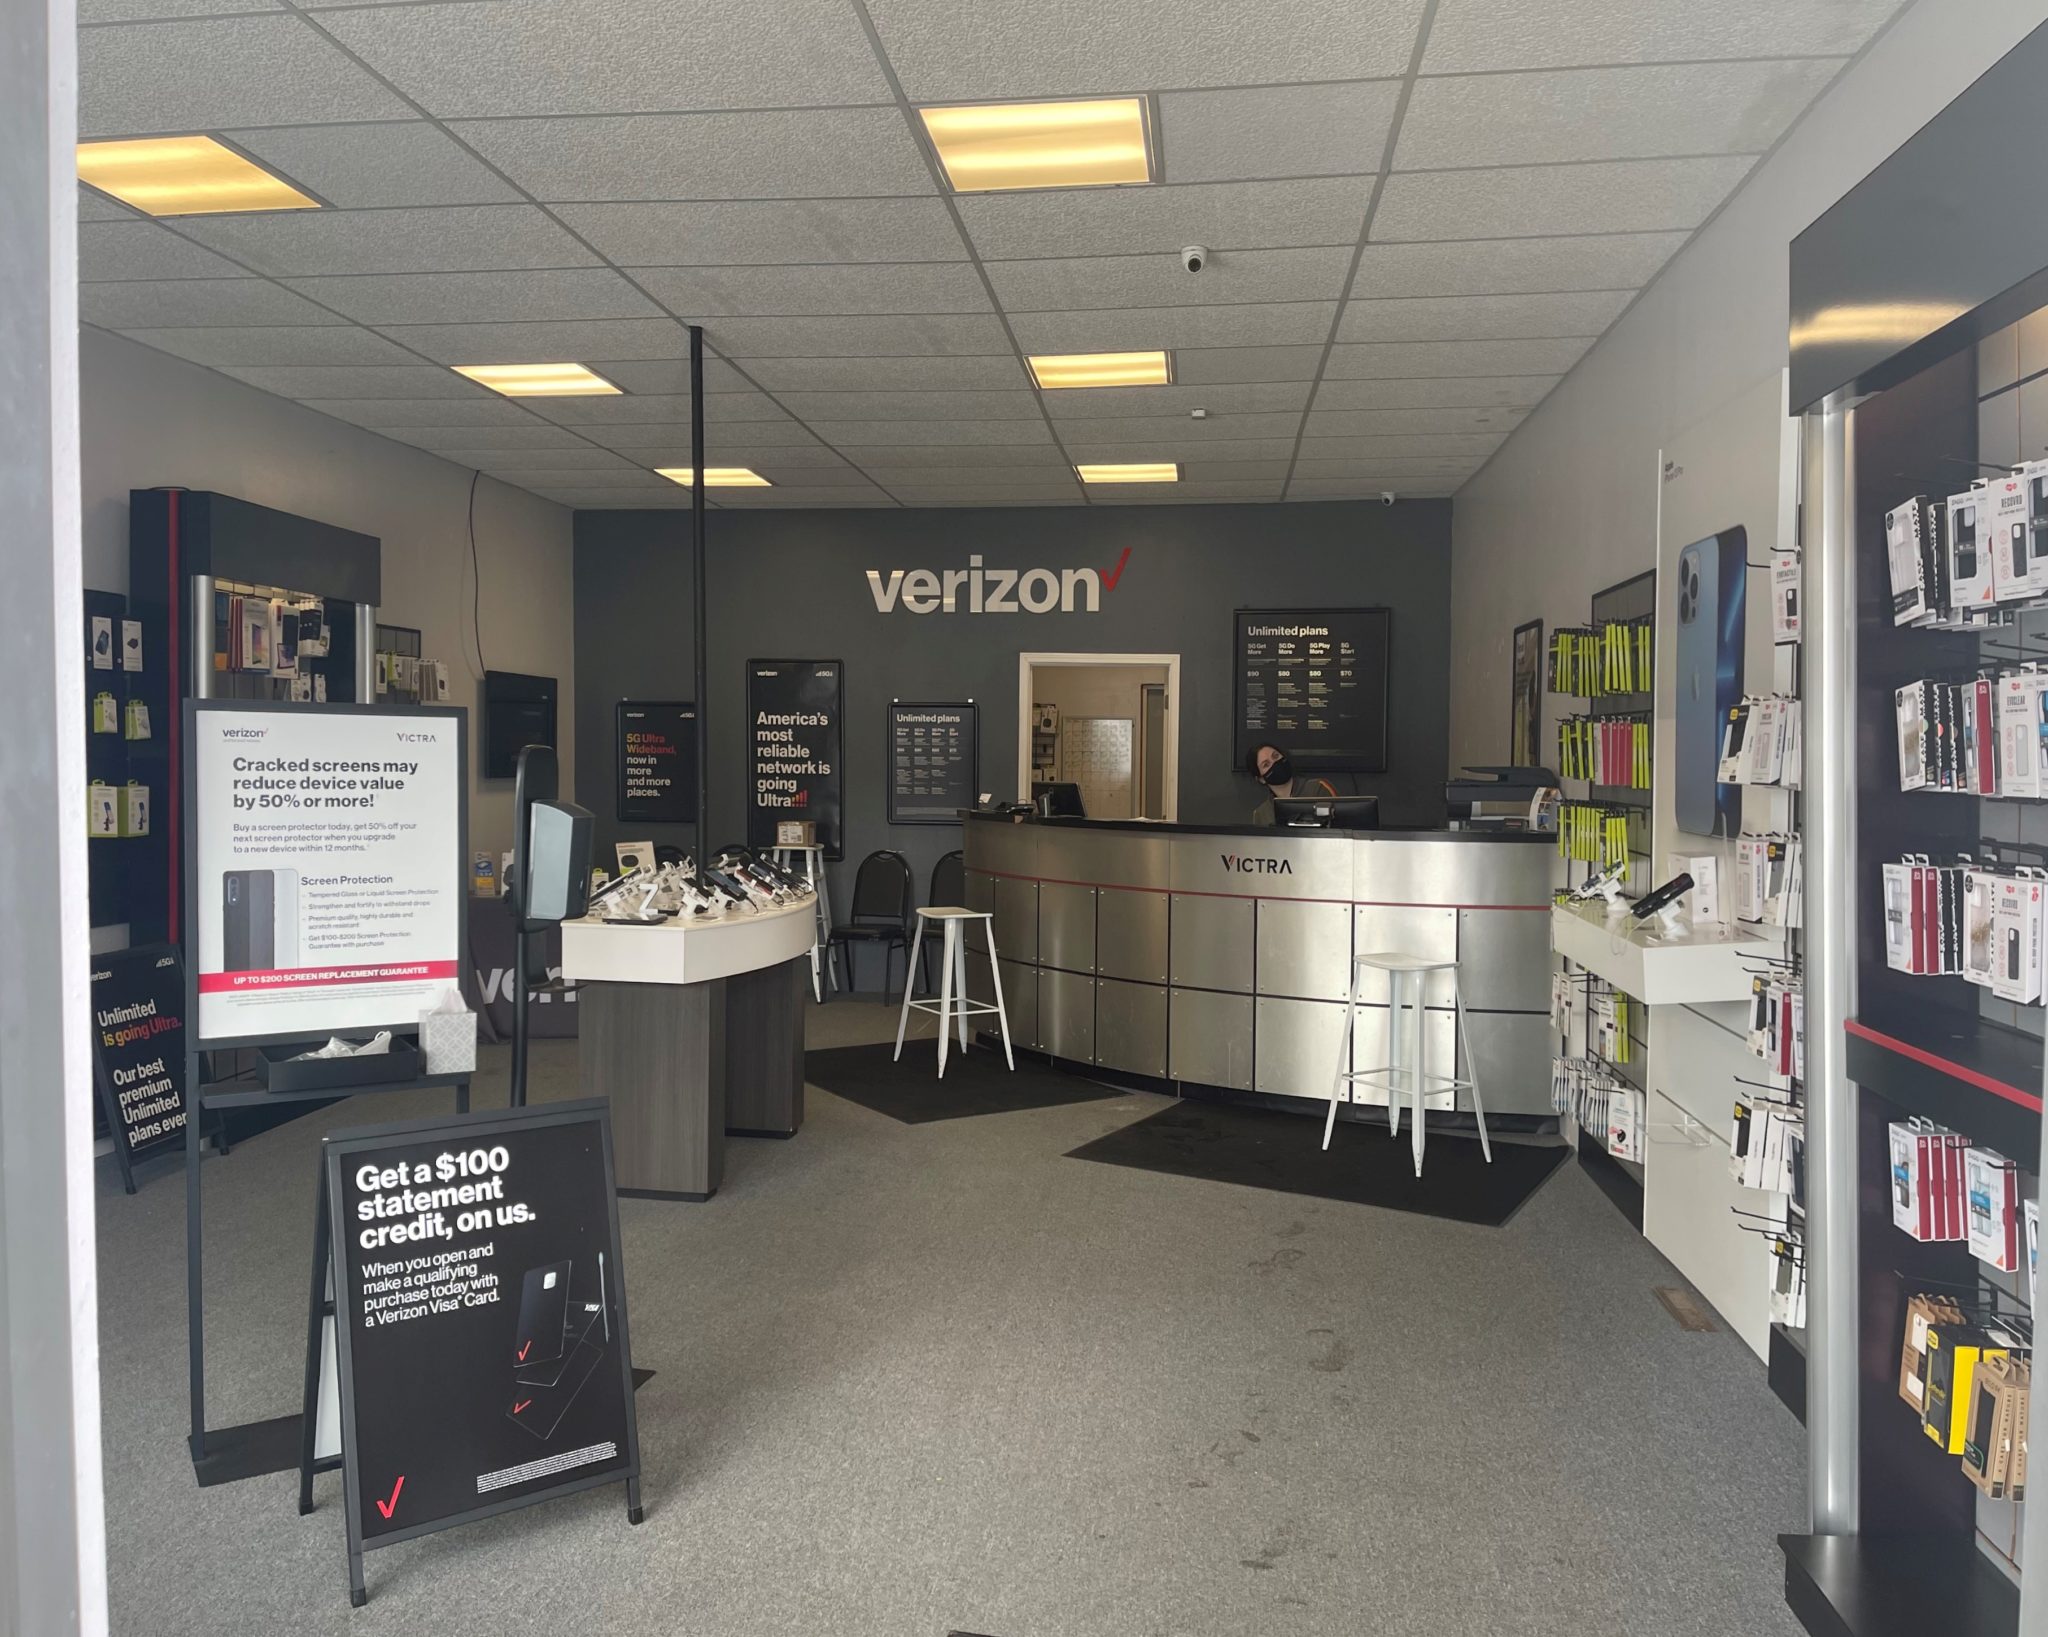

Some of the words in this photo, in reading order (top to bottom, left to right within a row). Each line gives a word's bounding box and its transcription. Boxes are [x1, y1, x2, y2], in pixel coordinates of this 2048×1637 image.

[866, 555, 1100, 613] verizon
[1248, 626, 1299, 636] Unlimited
[1299, 626, 1328, 637] plans
[757, 711, 829, 726] America's
[896, 714, 937, 722] Unlimited
[937, 714, 961, 724] plans
[222, 728, 264, 738] verizon
[396, 732, 437, 743] VICTRA
[627, 733, 641, 743] 5G
[642, 733, 665, 743] Ultra
[757, 728, 793, 741] most
[757, 744, 810, 758] reliable
[233, 757, 309, 772] Cracked
[312, 760, 381, 773] screens
[383, 761, 419, 775] may
[627, 756, 647, 765] now
[648, 755, 657, 765] in
[757, 761, 816, 774] network
[818, 761, 831, 775] is
[233, 776, 297, 790] reduce
[300, 776, 357, 790] device
[360, 777, 405, 790] value
[627, 777, 645, 786] and
[646, 778, 671, 786] more
[757, 777, 797, 792] going
[627, 787, 661, 798] places.
[757, 793, 792, 807] Ultra
[233, 794, 255, 811] by
[259, 794, 301, 808] 50%
[303, 797, 322, 808] or
[325, 794, 374, 808] more!
[233, 823, 250, 833] Buy
[287, 824, 326, 833] protector
[328, 823, 353, 832] today,
[354, 823, 367, 832] get
[387, 822, 399, 830] off
[400, 824, 417, 832] your
[284, 834, 323, 844] protector
[324, 833, 346, 841] when
[347, 834, 362, 843] you
[363, 833, 396, 842] upgrade
[269, 845, 297, 853] device
[334, 844, 366, 852] months.
[1221, 854, 1292, 874] VICTRA
[301, 877, 338, 886] Screen
[340, 876, 393, 885] Protection
[308, 903, 343, 911] Strengthen
[234, 977, 246, 985] UP
[249, 976, 260, 984] TO
[260, 974, 283, 984] $200
[283, 972, 318, 982] SCREEN
[318, 969, 379, 980] REPLACEMENT
[380, 966, 429, 976] GUARANTEE
[97, 999, 157, 1027] Unlimited
[102, 1031, 115, 1047] is
[115, 1023, 150, 1047] going
[149, 1016, 182, 1035] Ultra.
[113, 1069, 136, 1086] Our
[138, 1058, 165, 1077] best
[119, 1077, 173, 1108] premium
[122, 1091, 181, 1125] Unlimited
[128, 1121, 161, 1148] plans
[356, 1162, 410, 1192] Get
[414, 1163, 432, 1184] a
[435, 1146, 510, 1183] $100
[357, 1175, 504, 1221] statement
[359, 1212, 453, 1250] credit,
[456, 1208, 493, 1232] on
[496, 1202, 536, 1226] us.
[362, 1261, 404, 1279] When
[405, 1257, 431, 1274] you
[433, 1250, 467, 1267] open
[469, 1242, 494, 1259] and
[363, 1277, 401, 1295] make
[403, 1277, 412, 1288] a
[413, 1263, 478, 1287] qualifying
[364, 1288, 429, 1314] purchase
[431, 1280, 469, 1298] today
[470, 1273, 499, 1290] with
[365, 1316, 375, 1327] a
[376, 1304, 428, 1325] Verizon
[464, 1288, 500, 1307] Card.
